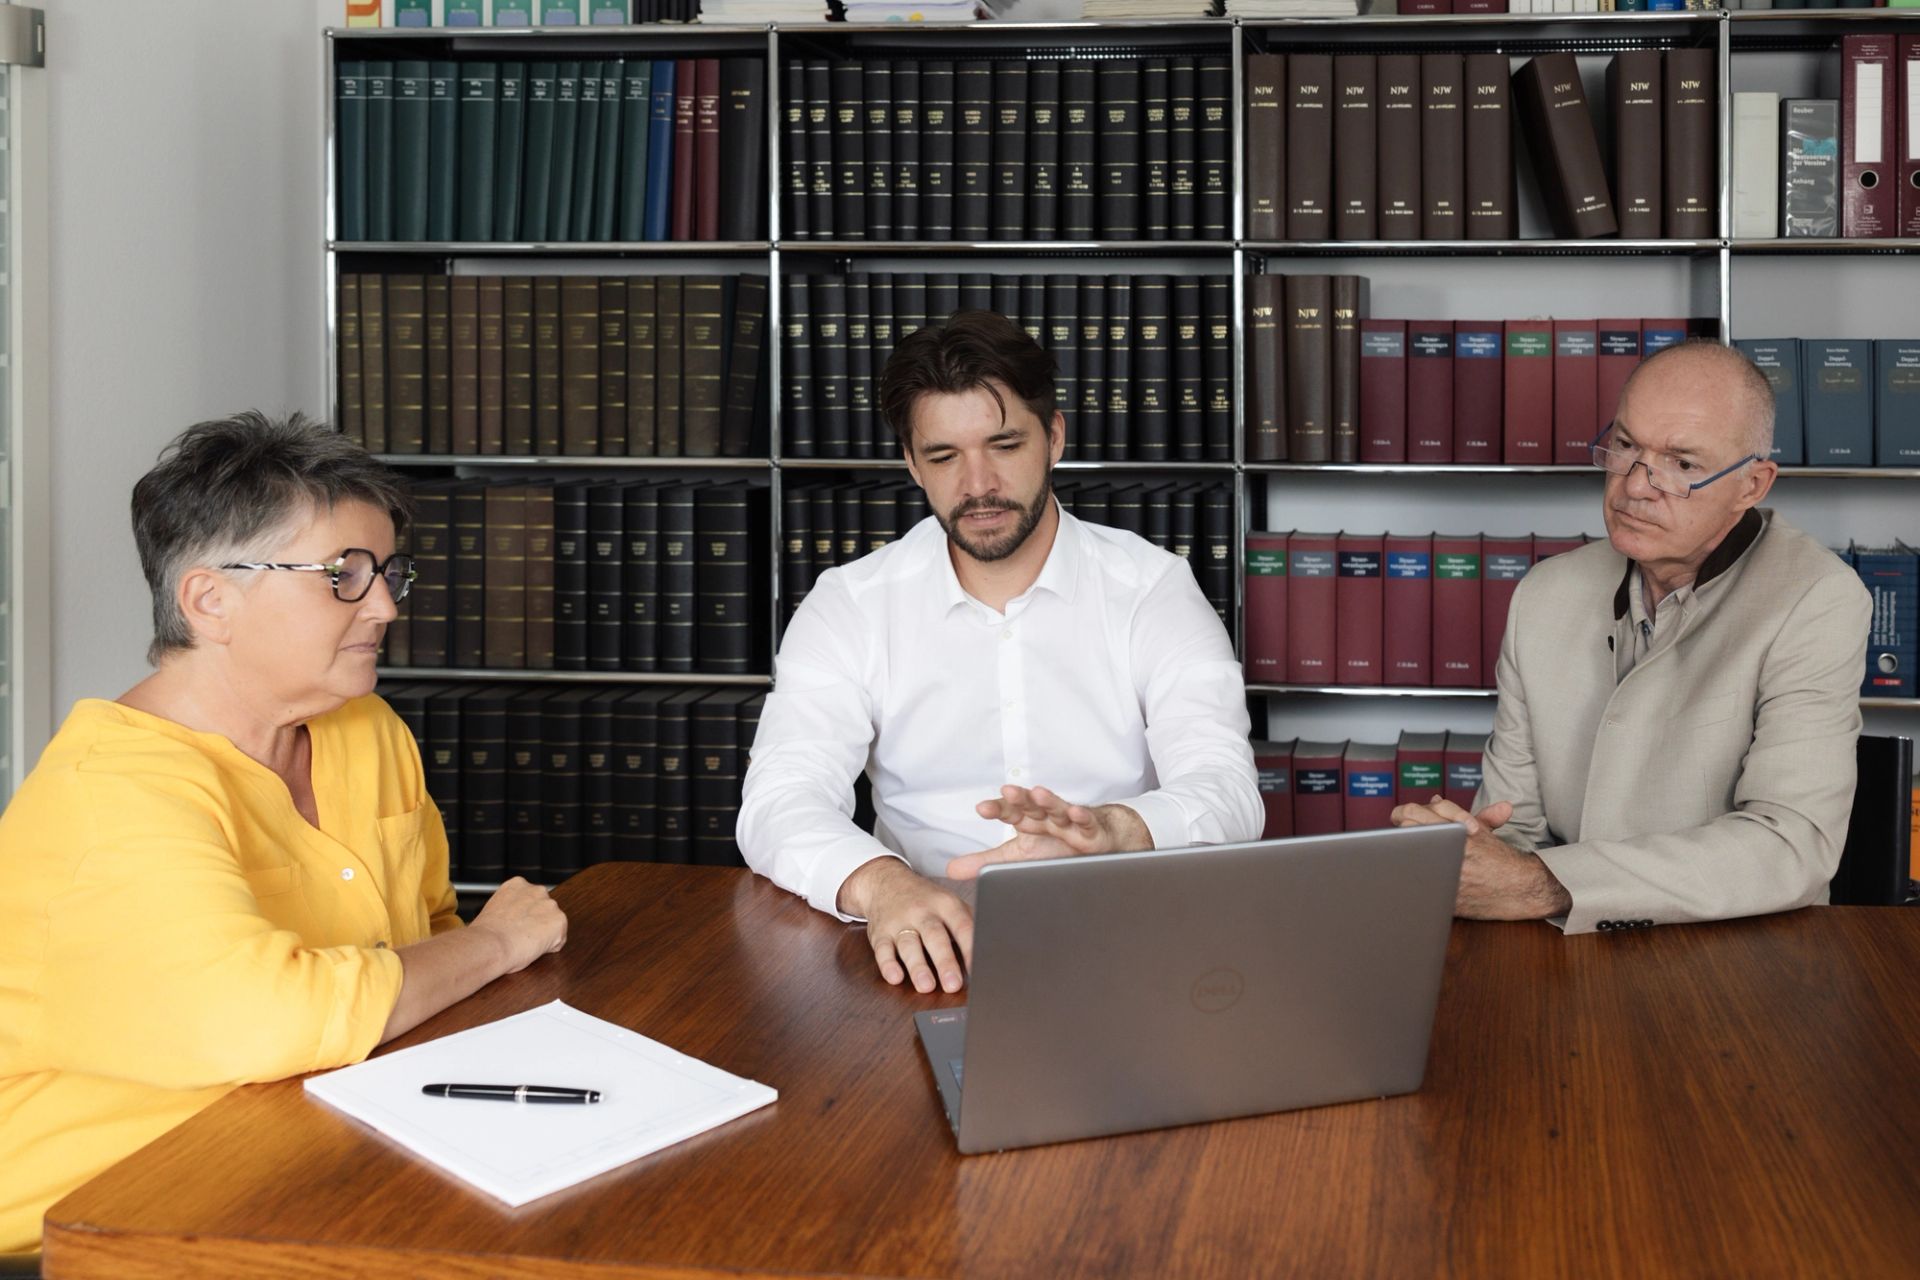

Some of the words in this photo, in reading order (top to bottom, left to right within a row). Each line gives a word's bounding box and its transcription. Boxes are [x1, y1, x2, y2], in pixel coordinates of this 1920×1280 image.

[1553, 83, 1572, 93] NJW
[1630, 82, 1650, 91] NJW
[1680, 80, 1701, 89] NJW
[1254, 86, 1274, 95] NJW
[1300, 85, 1320, 94] NJW
[1345, 86, 1365, 95] NJW
[1390, 86, 1409, 95] NJW
[1432, 85, 1452, 94] NJW
[1477, 85, 1497, 94] NJW
[1253, 306, 1273, 317] NJW
[1298, 308, 1319, 318] NJW
[1335, 308, 1354, 319] NJW
